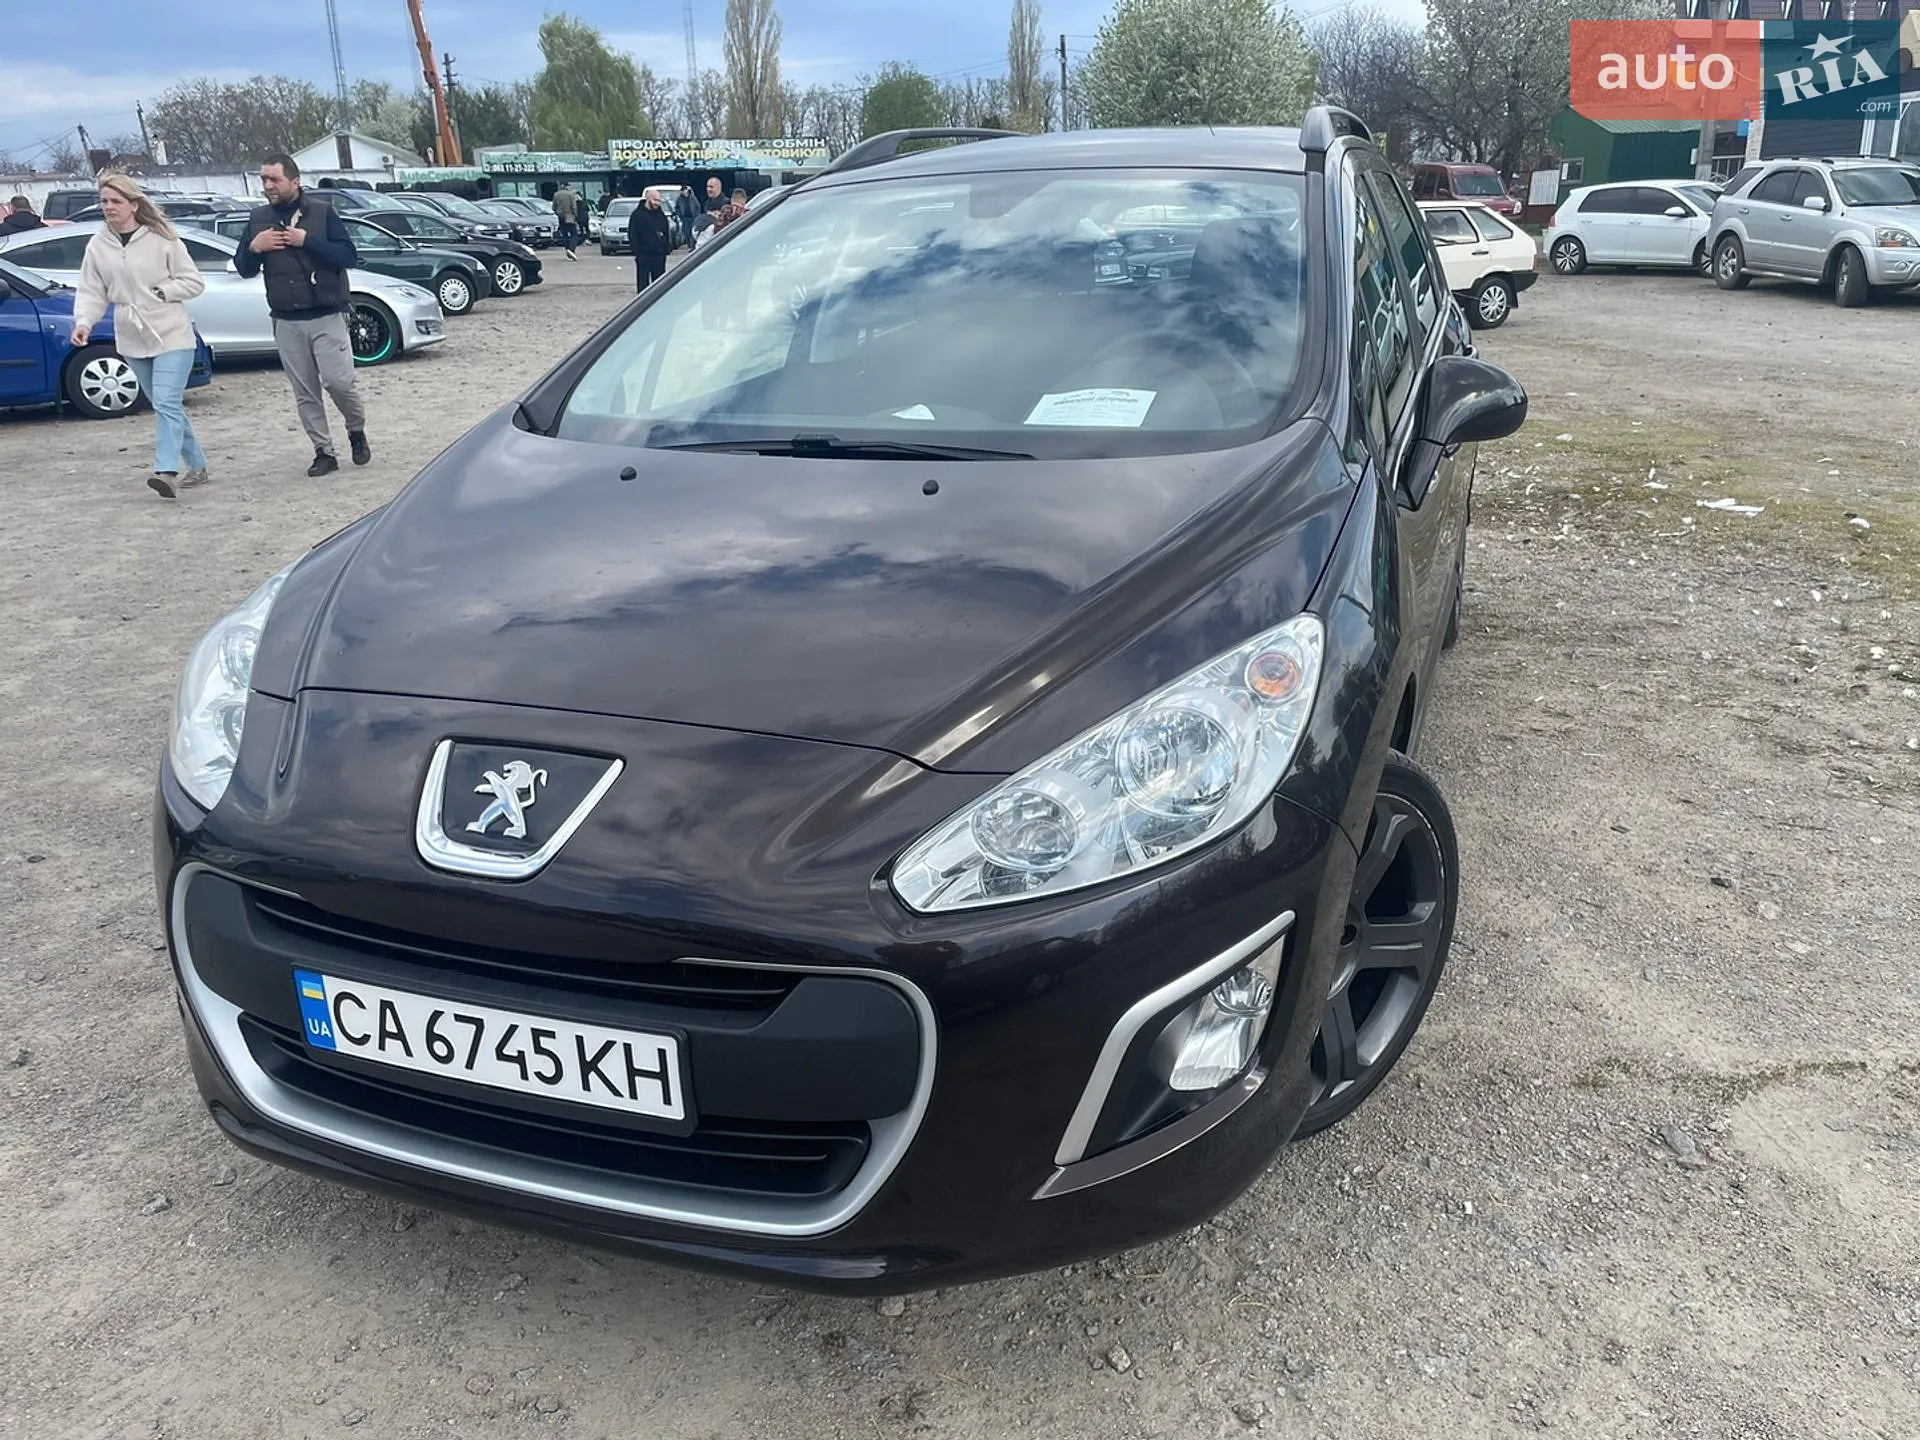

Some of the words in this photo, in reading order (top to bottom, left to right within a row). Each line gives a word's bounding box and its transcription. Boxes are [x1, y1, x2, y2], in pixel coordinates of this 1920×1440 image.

[612, 140, 679, 151] ПРОДАЖ
[702, 140, 757, 150] ПІДБІР
[772, 138, 826, 148] ОБМІН
[613, 149, 671, 160] ДОГОВІР
[746, 149, 826, 159] ТОВИКУП
[308, 1016, 333, 1039] UA
[333, 991, 414, 1058] CA
[425, 1010, 564, 1086] 6745
[575, 1035, 673, 1106] KH
